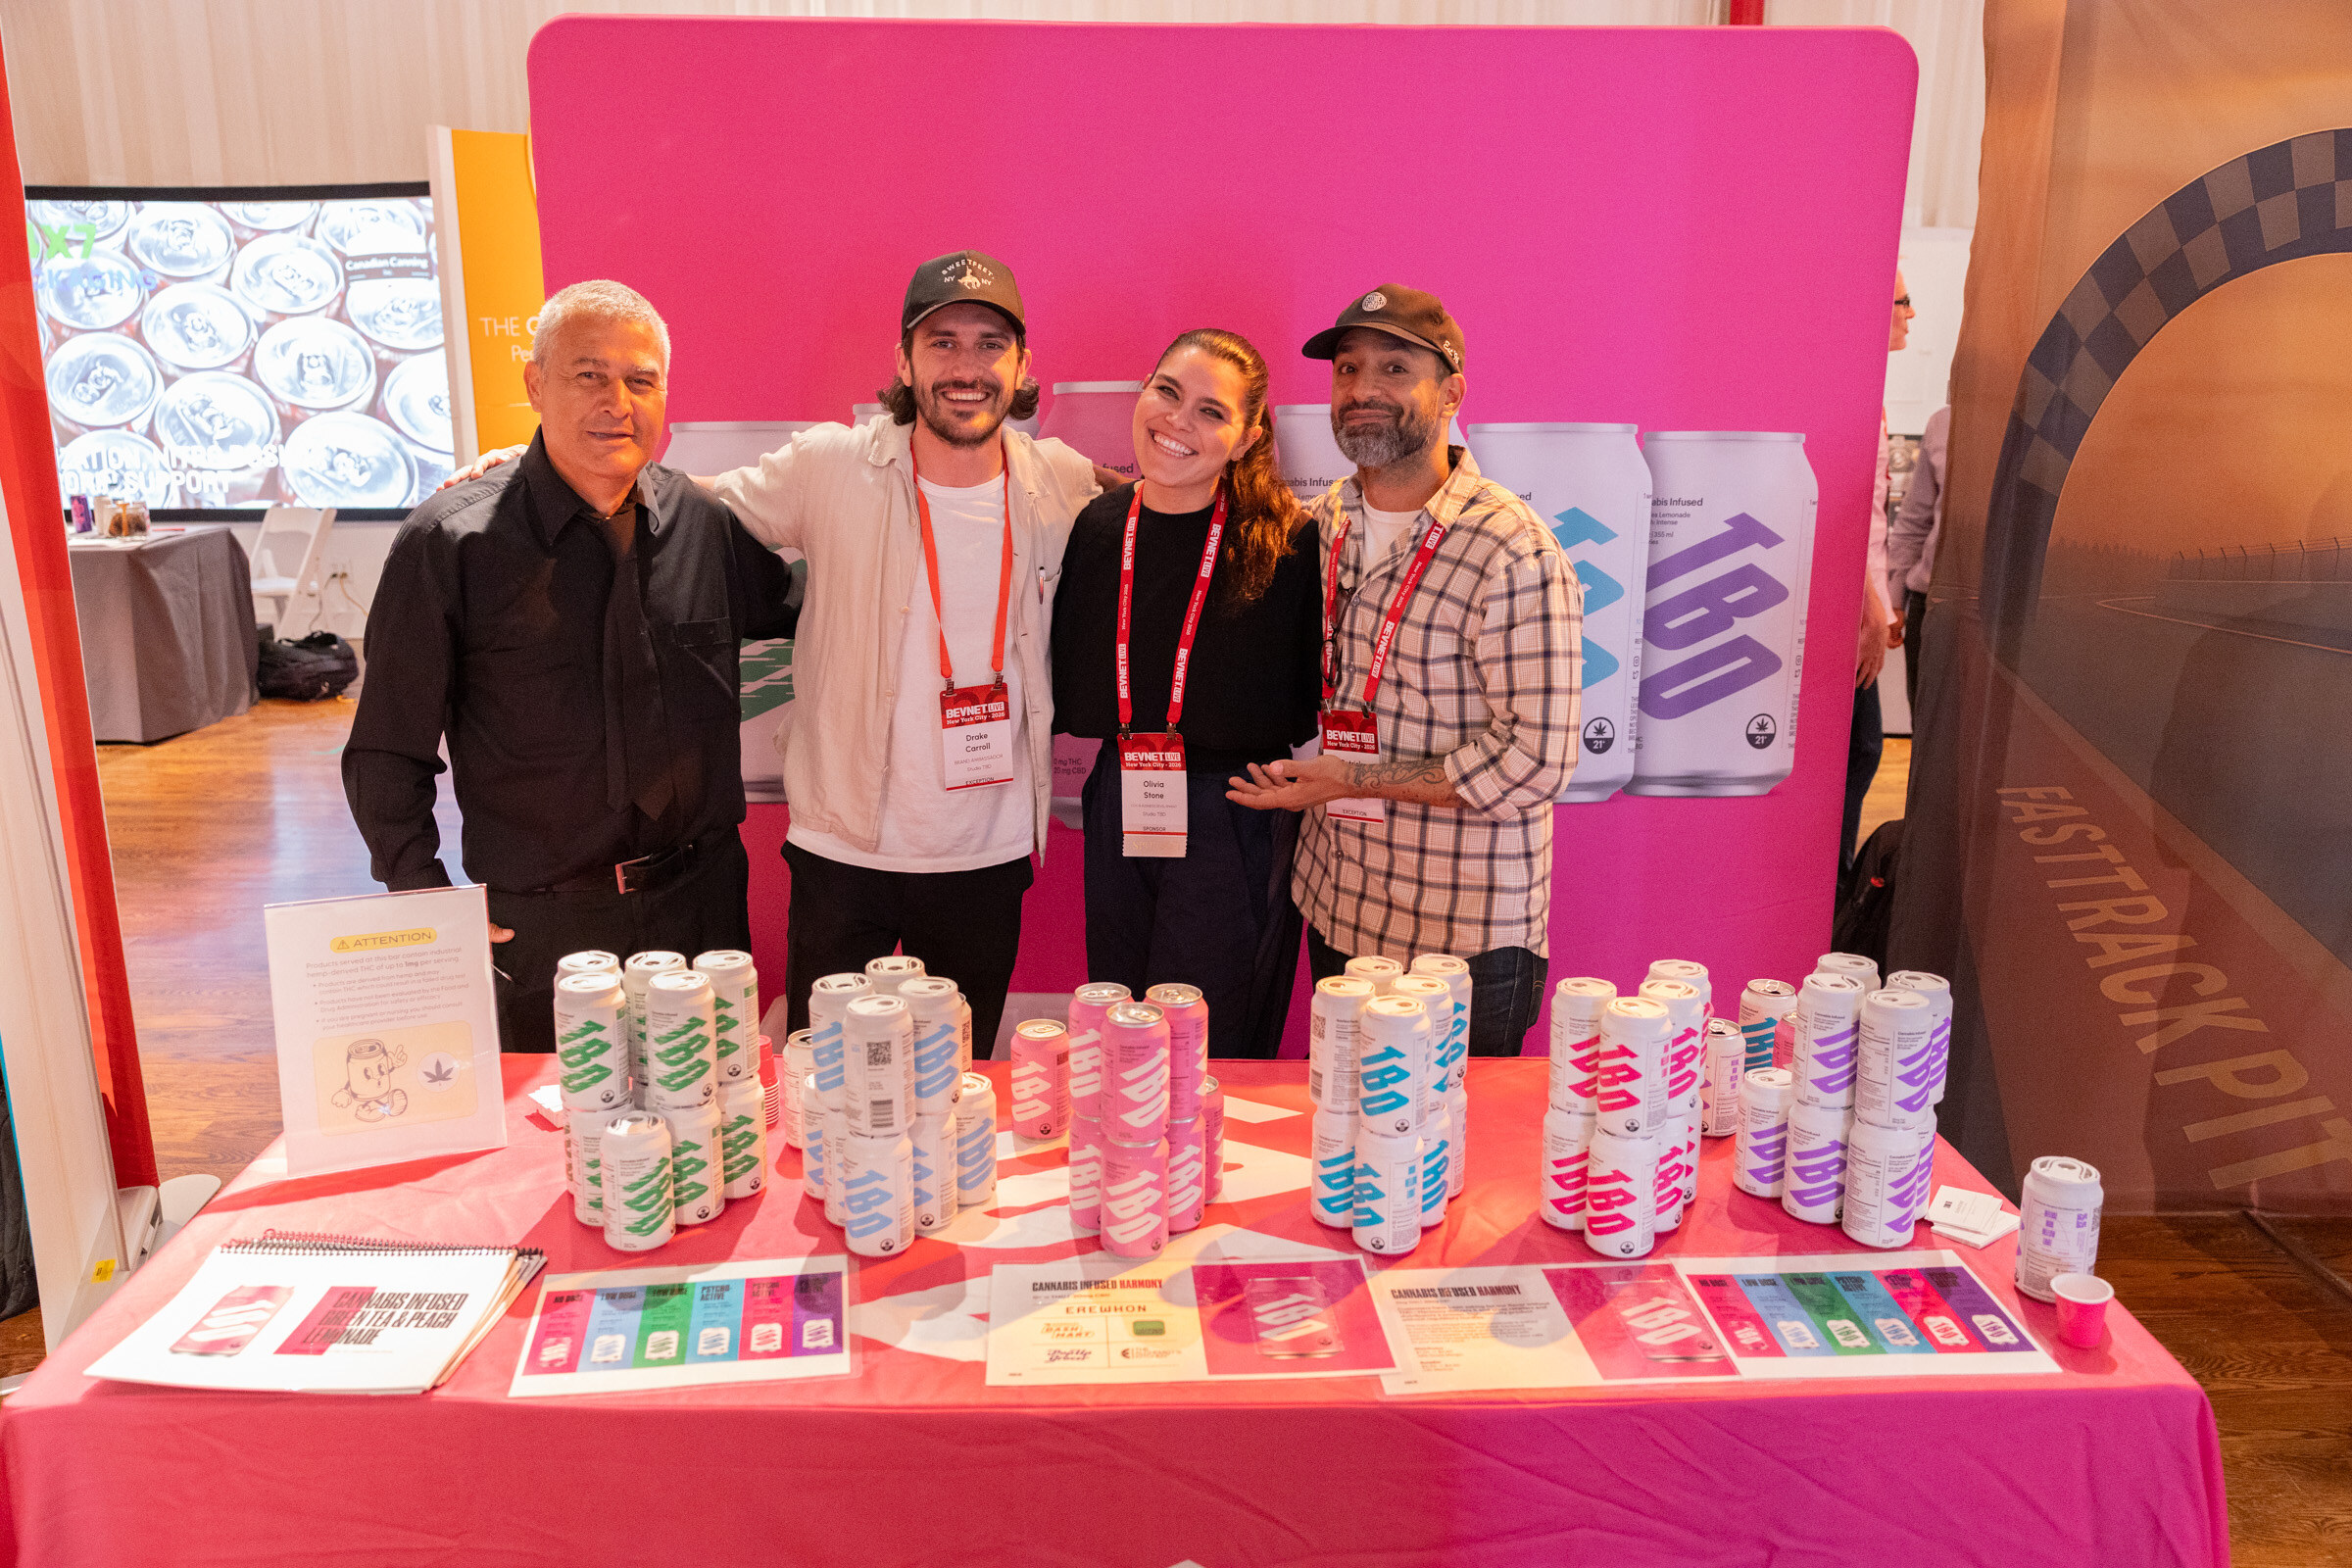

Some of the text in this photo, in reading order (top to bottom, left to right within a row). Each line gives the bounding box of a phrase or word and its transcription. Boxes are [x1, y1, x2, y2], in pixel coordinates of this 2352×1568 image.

[31, 270, 158, 291] CKAGING
[478, 317, 520, 336] THE
[1670, 498, 1703, 507] Infused
[1123, 531, 1135, 570] BEVNET
[1200, 523, 1221, 578] BEVNET LIVE
[1376, 621, 1395, 662] BEVNET
[1118, 643, 1128, 699] BEVNET LIVE
[1173, 648, 1188, 704] BEVNET LIVE
[946, 702, 1004, 719] BEVNET LIVE
[966, 732, 988, 742] Drake
[1326, 730, 1374, 744] BEVNET LIVE
[965, 743, 991, 753] Carroll
[1124, 753, 1181, 761] BEVNET LIVE
[353, 932, 432, 948] ATTENTION
[306, 960, 339, 969] Products
[340, 957, 364, 966] served
[402, 951, 428, 959] contain
[429, 947, 462, 956] industrial
[307, 968, 359, 978] hemp-derived
[420, 959, 432, 968] per
[2155, 1049, 2352, 1190] PIT
[1032, 1279, 1163, 1292] CANNABIS INFUSED HARMONY
[1391, 1288, 1439, 1299] CANNABIS
[1476, 1285, 1522, 1297] HARMONY
[333, 1292, 469, 1310] CANNABIS INFUSED
[700, 1293, 725, 1301] ACTIVE
[1065, 1304, 1147, 1314] EREWHON
[368, 1310, 394, 1327] TEA
[392, 1311, 409, 1328] &
[405, 1312, 459, 1328] PEACH
[303, 1327, 383, 1345] LEMONADE
